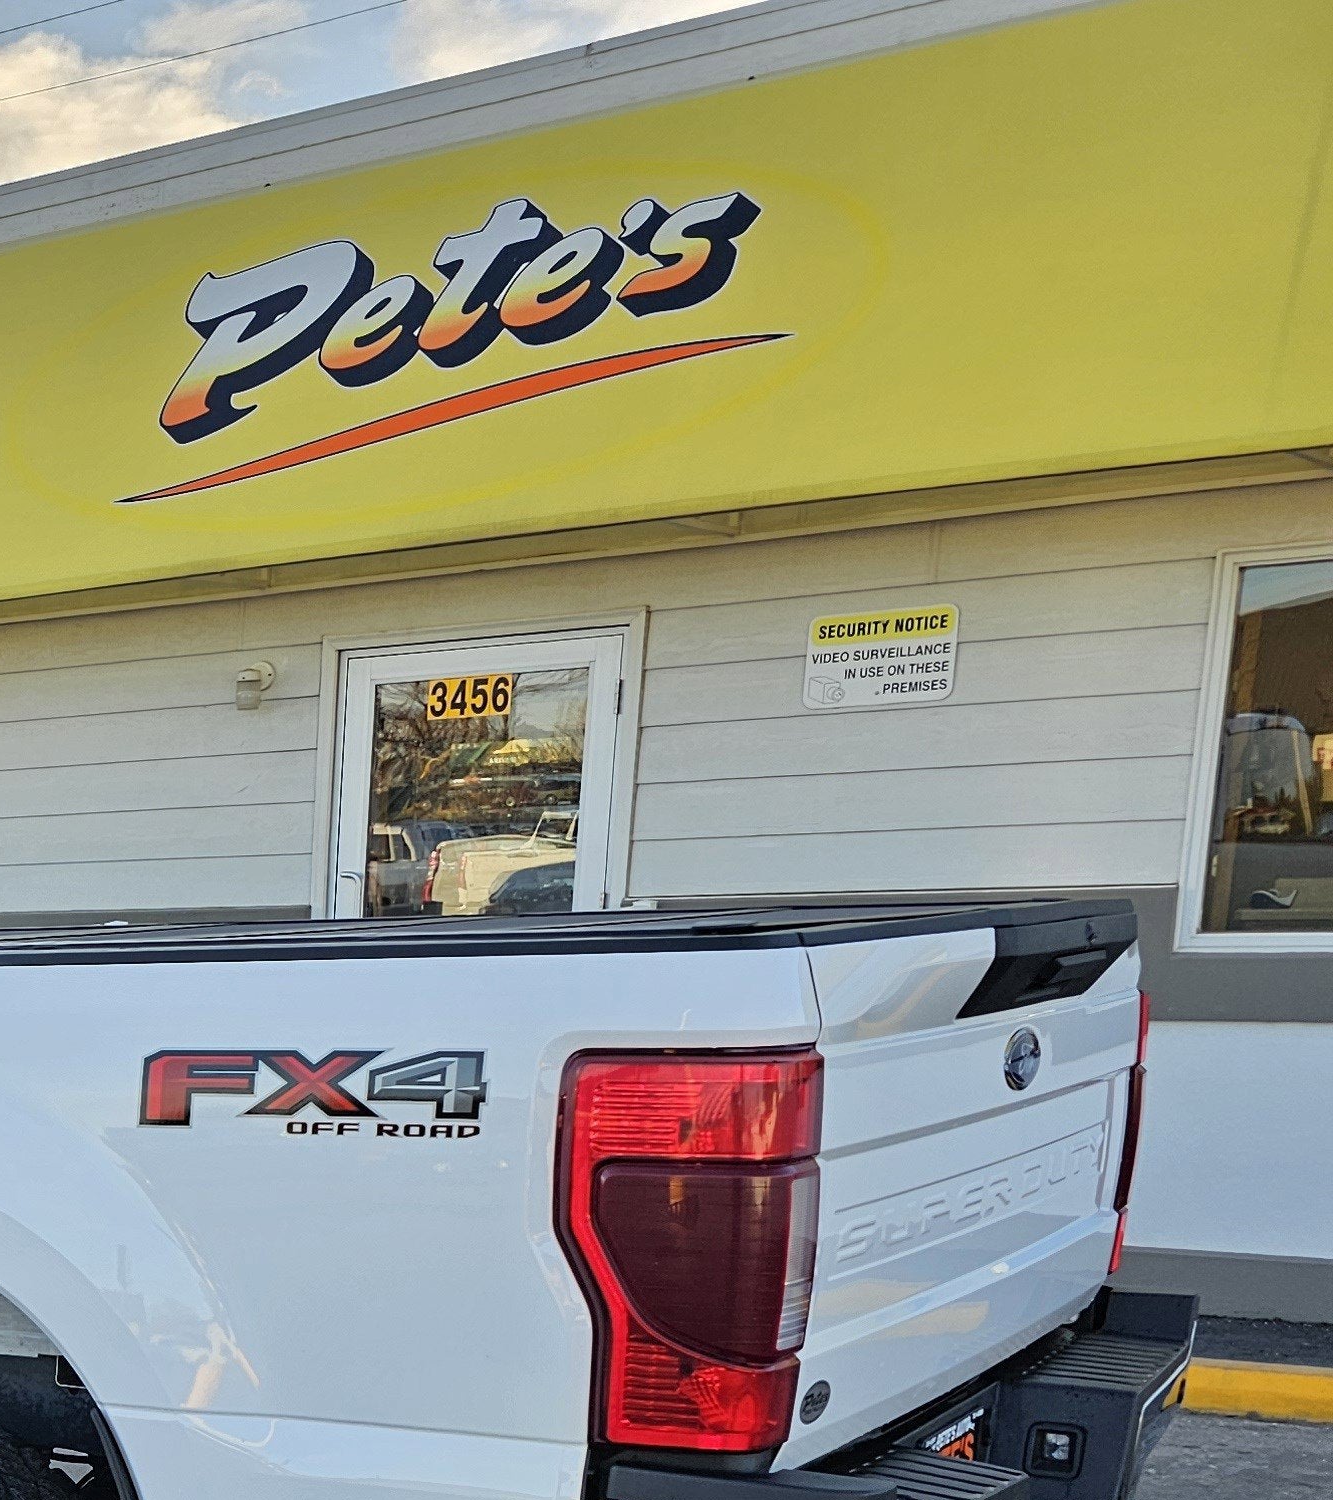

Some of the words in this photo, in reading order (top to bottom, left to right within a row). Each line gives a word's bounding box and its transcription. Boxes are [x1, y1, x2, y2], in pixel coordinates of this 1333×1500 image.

[158, 190, 763, 445] Pete's
[818, 619, 890, 640] SECURITY
[894, 614, 949, 633] NOTICE
[811, 651, 850, 665] VIDEO
[852, 642, 952, 662] SURVEILLANCE
[843, 668, 856, 680] IN
[859, 665, 884, 679] USE
[887, 664, 906, 677] ON
[909, 660, 950, 674] THESE
[429, 676, 511, 718] 3456
[882, 678, 948, 695] PREMISES
[139, 1050, 487, 1126] FX4
[286, 1121, 360, 1136] OFF
[376, 1123, 481, 1139] ROAD
